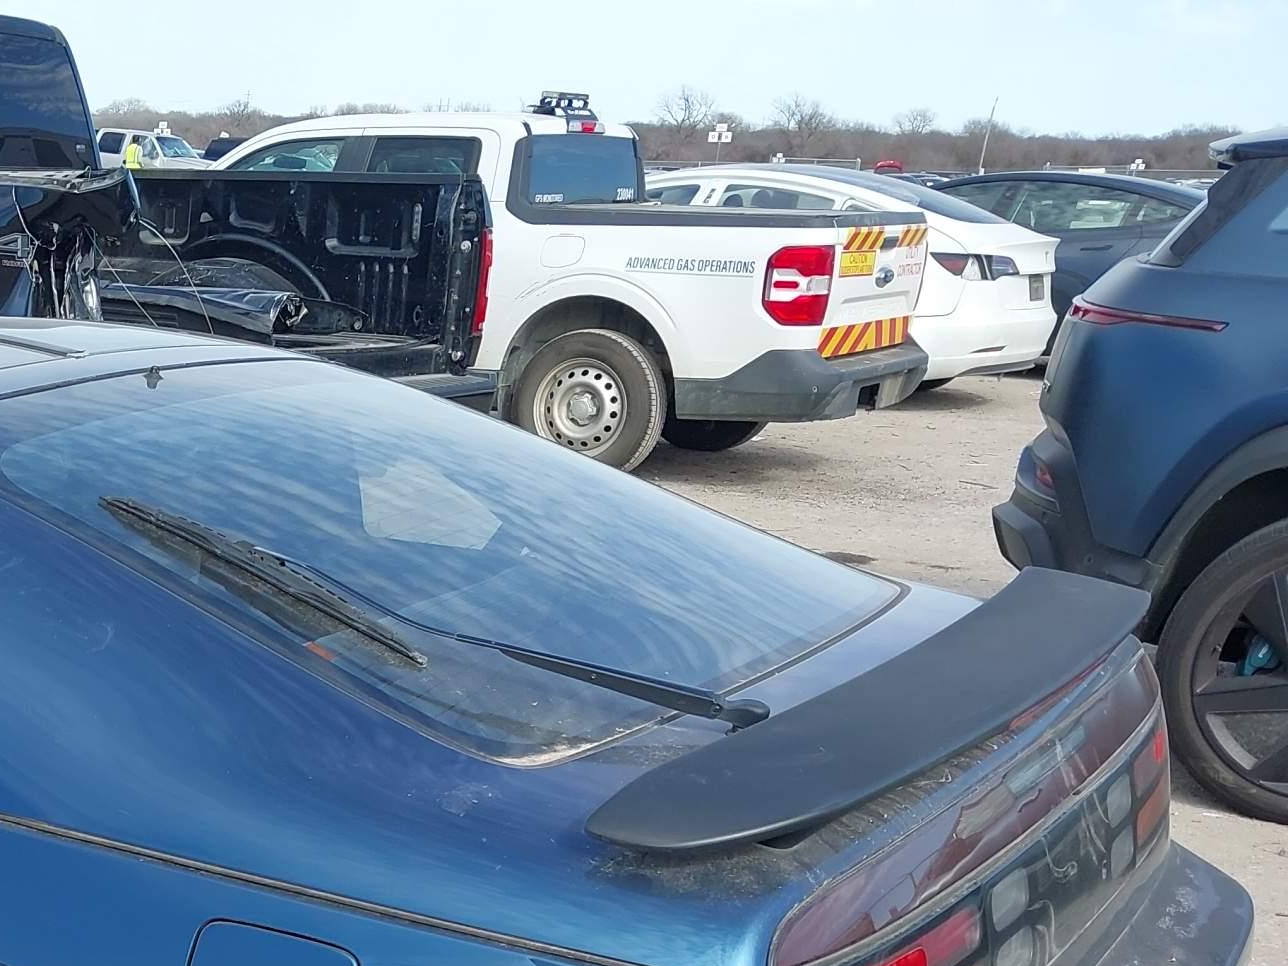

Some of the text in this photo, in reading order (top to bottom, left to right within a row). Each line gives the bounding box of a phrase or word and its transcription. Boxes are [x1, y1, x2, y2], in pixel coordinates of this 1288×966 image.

[625, 257, 756, 274] ADVANCED GAS OPERATIONS
